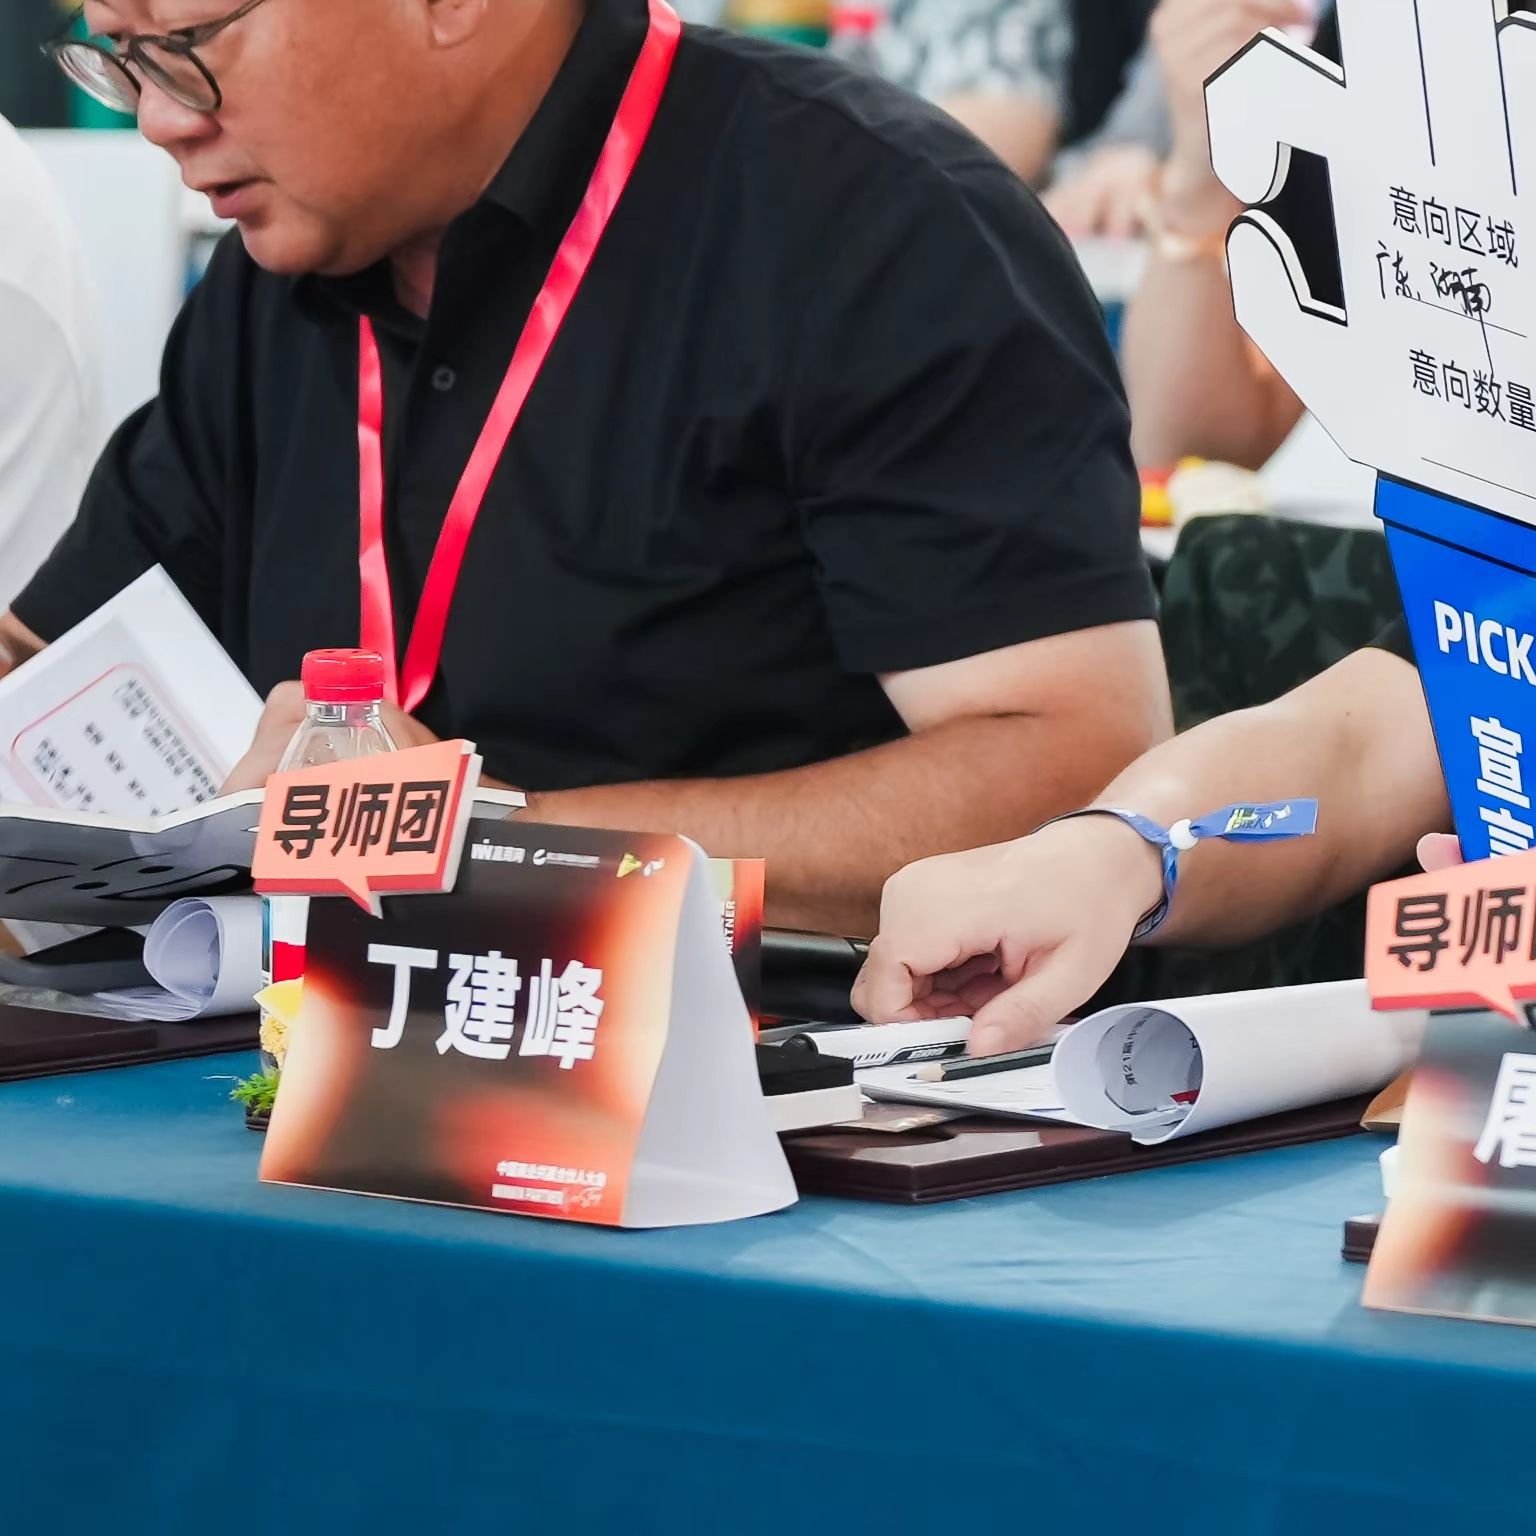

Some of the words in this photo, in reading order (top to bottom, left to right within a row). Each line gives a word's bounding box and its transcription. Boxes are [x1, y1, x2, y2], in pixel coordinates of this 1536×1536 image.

[1389, 186, 1519, 269] 意向区域
[272, 779, 452, 860] 导师团
[723, 899, 737, 956] ARTNER
[366, 943, 605, 1070] 丁建峰
